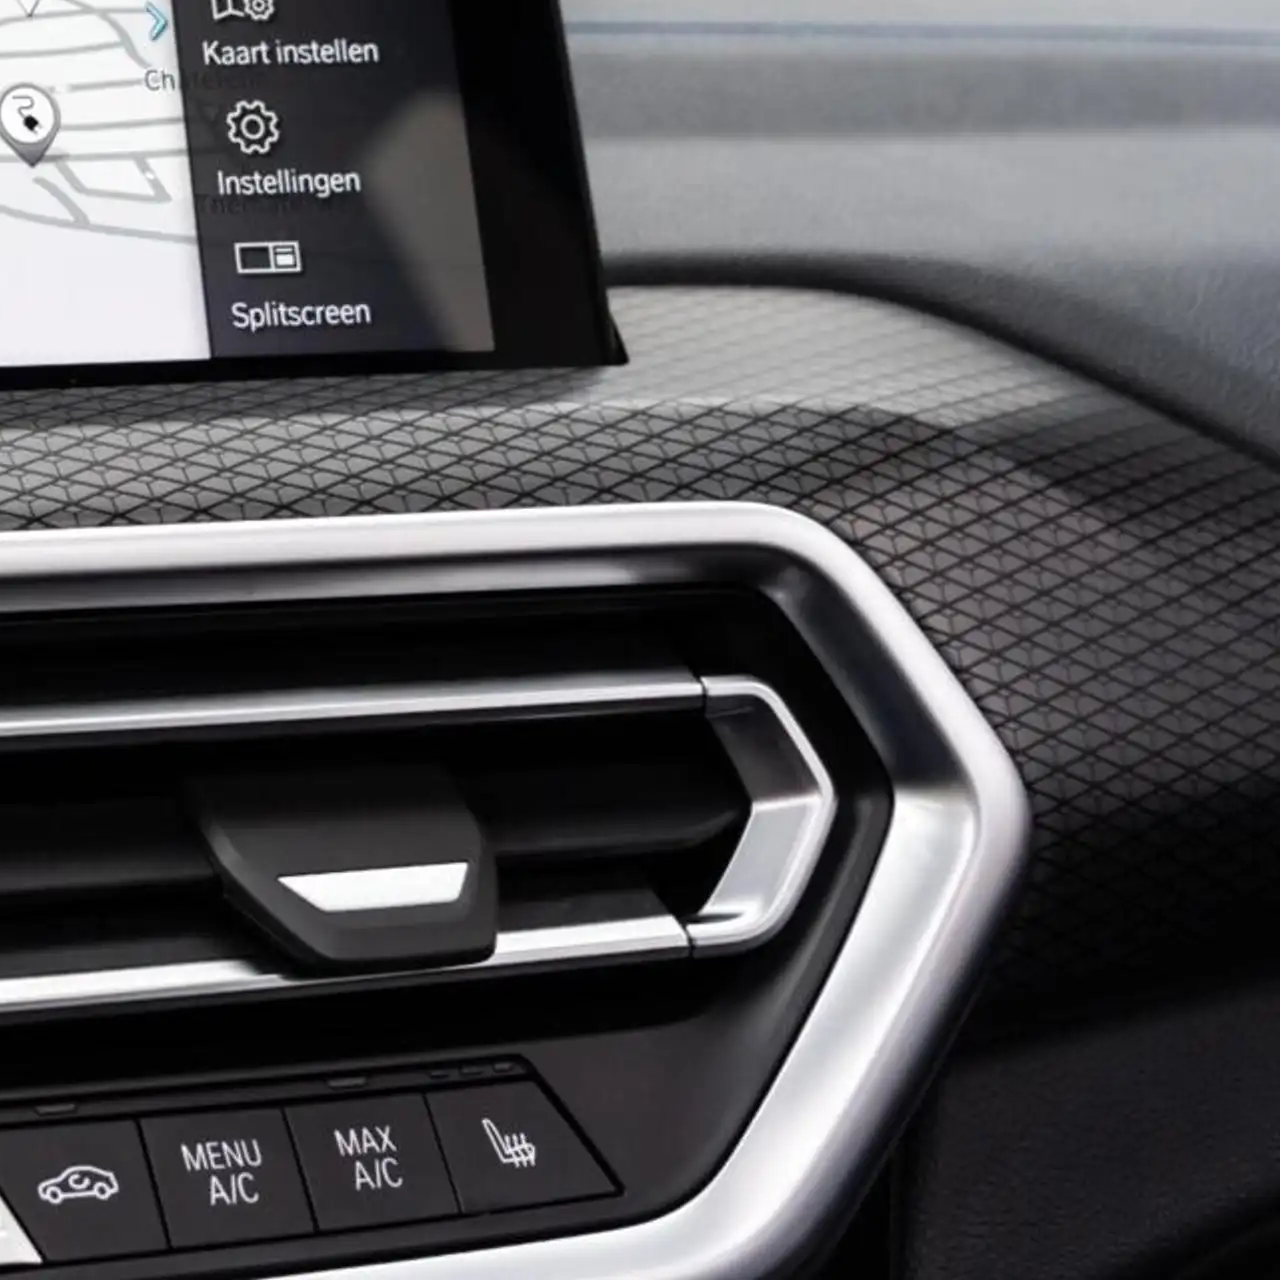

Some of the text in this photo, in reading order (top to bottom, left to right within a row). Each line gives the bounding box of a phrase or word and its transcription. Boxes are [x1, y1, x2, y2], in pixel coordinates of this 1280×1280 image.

[202, 38, 380, 66] Kaart instellen
[218, 170, 362, 197] Instellingen
[232, 301, 372, 332] Splitscreen
[182, 1139, 263, 1173] MENU
[335, 1126, 397, 1158] MAX
[209, 1173, 260, 1207] A/C
[354, 1158, 404, 1192] A/C
